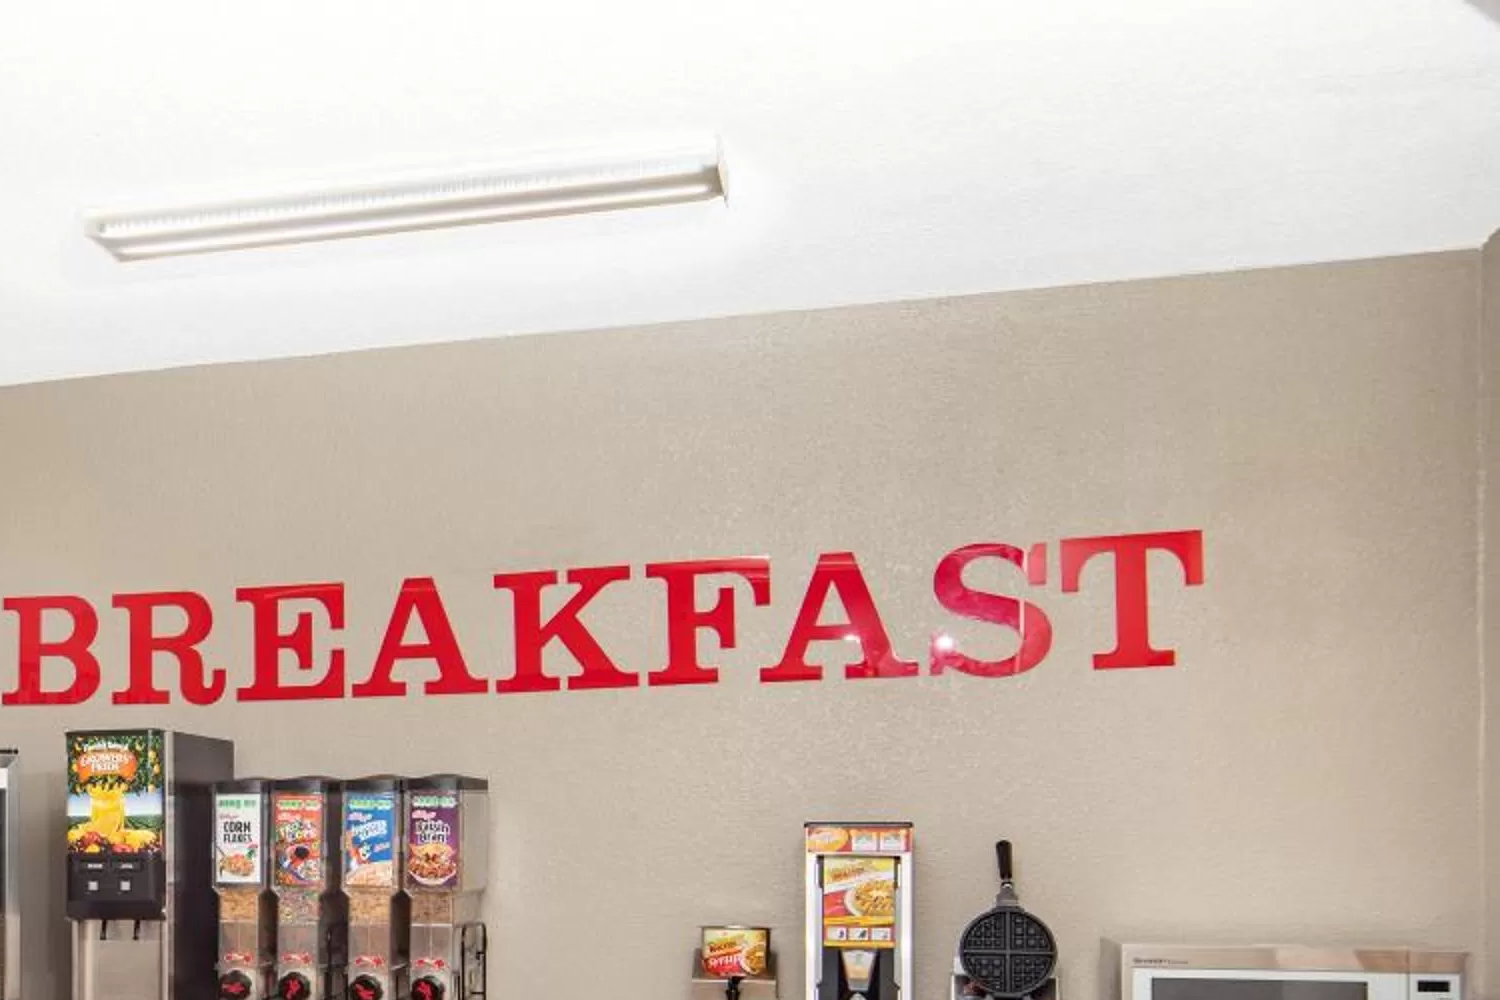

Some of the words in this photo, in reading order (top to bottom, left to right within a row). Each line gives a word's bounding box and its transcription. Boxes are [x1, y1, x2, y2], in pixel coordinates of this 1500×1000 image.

[2, 530, 1204, 706] BREAKFAST
[223, 821, 251, 833] CORN
[223, 833, 252, 844] FLAKES
